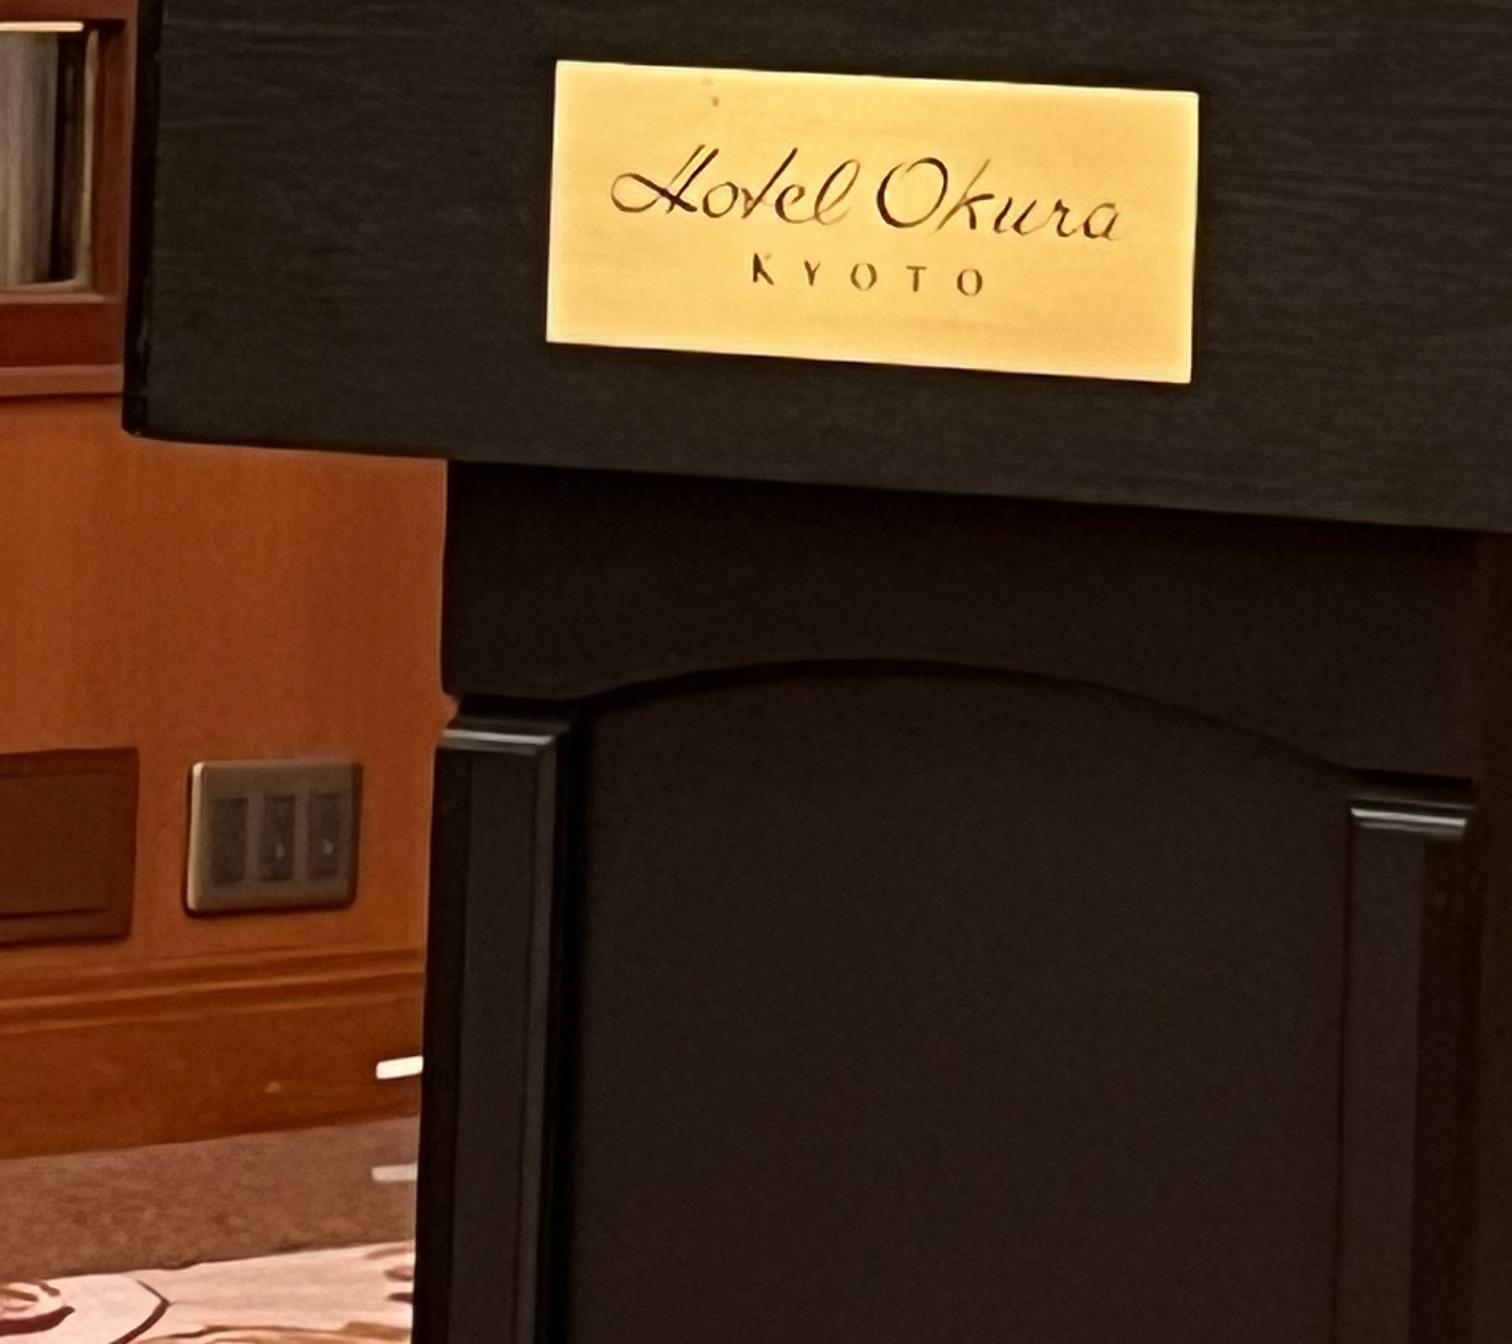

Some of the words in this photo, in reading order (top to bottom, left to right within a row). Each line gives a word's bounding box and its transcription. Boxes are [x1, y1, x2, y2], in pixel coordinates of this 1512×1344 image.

[609, 144, 860, 225] Hotel
[876, 156, 1121, 241] Okura
[752, 252, 984, 297] KYOTO
